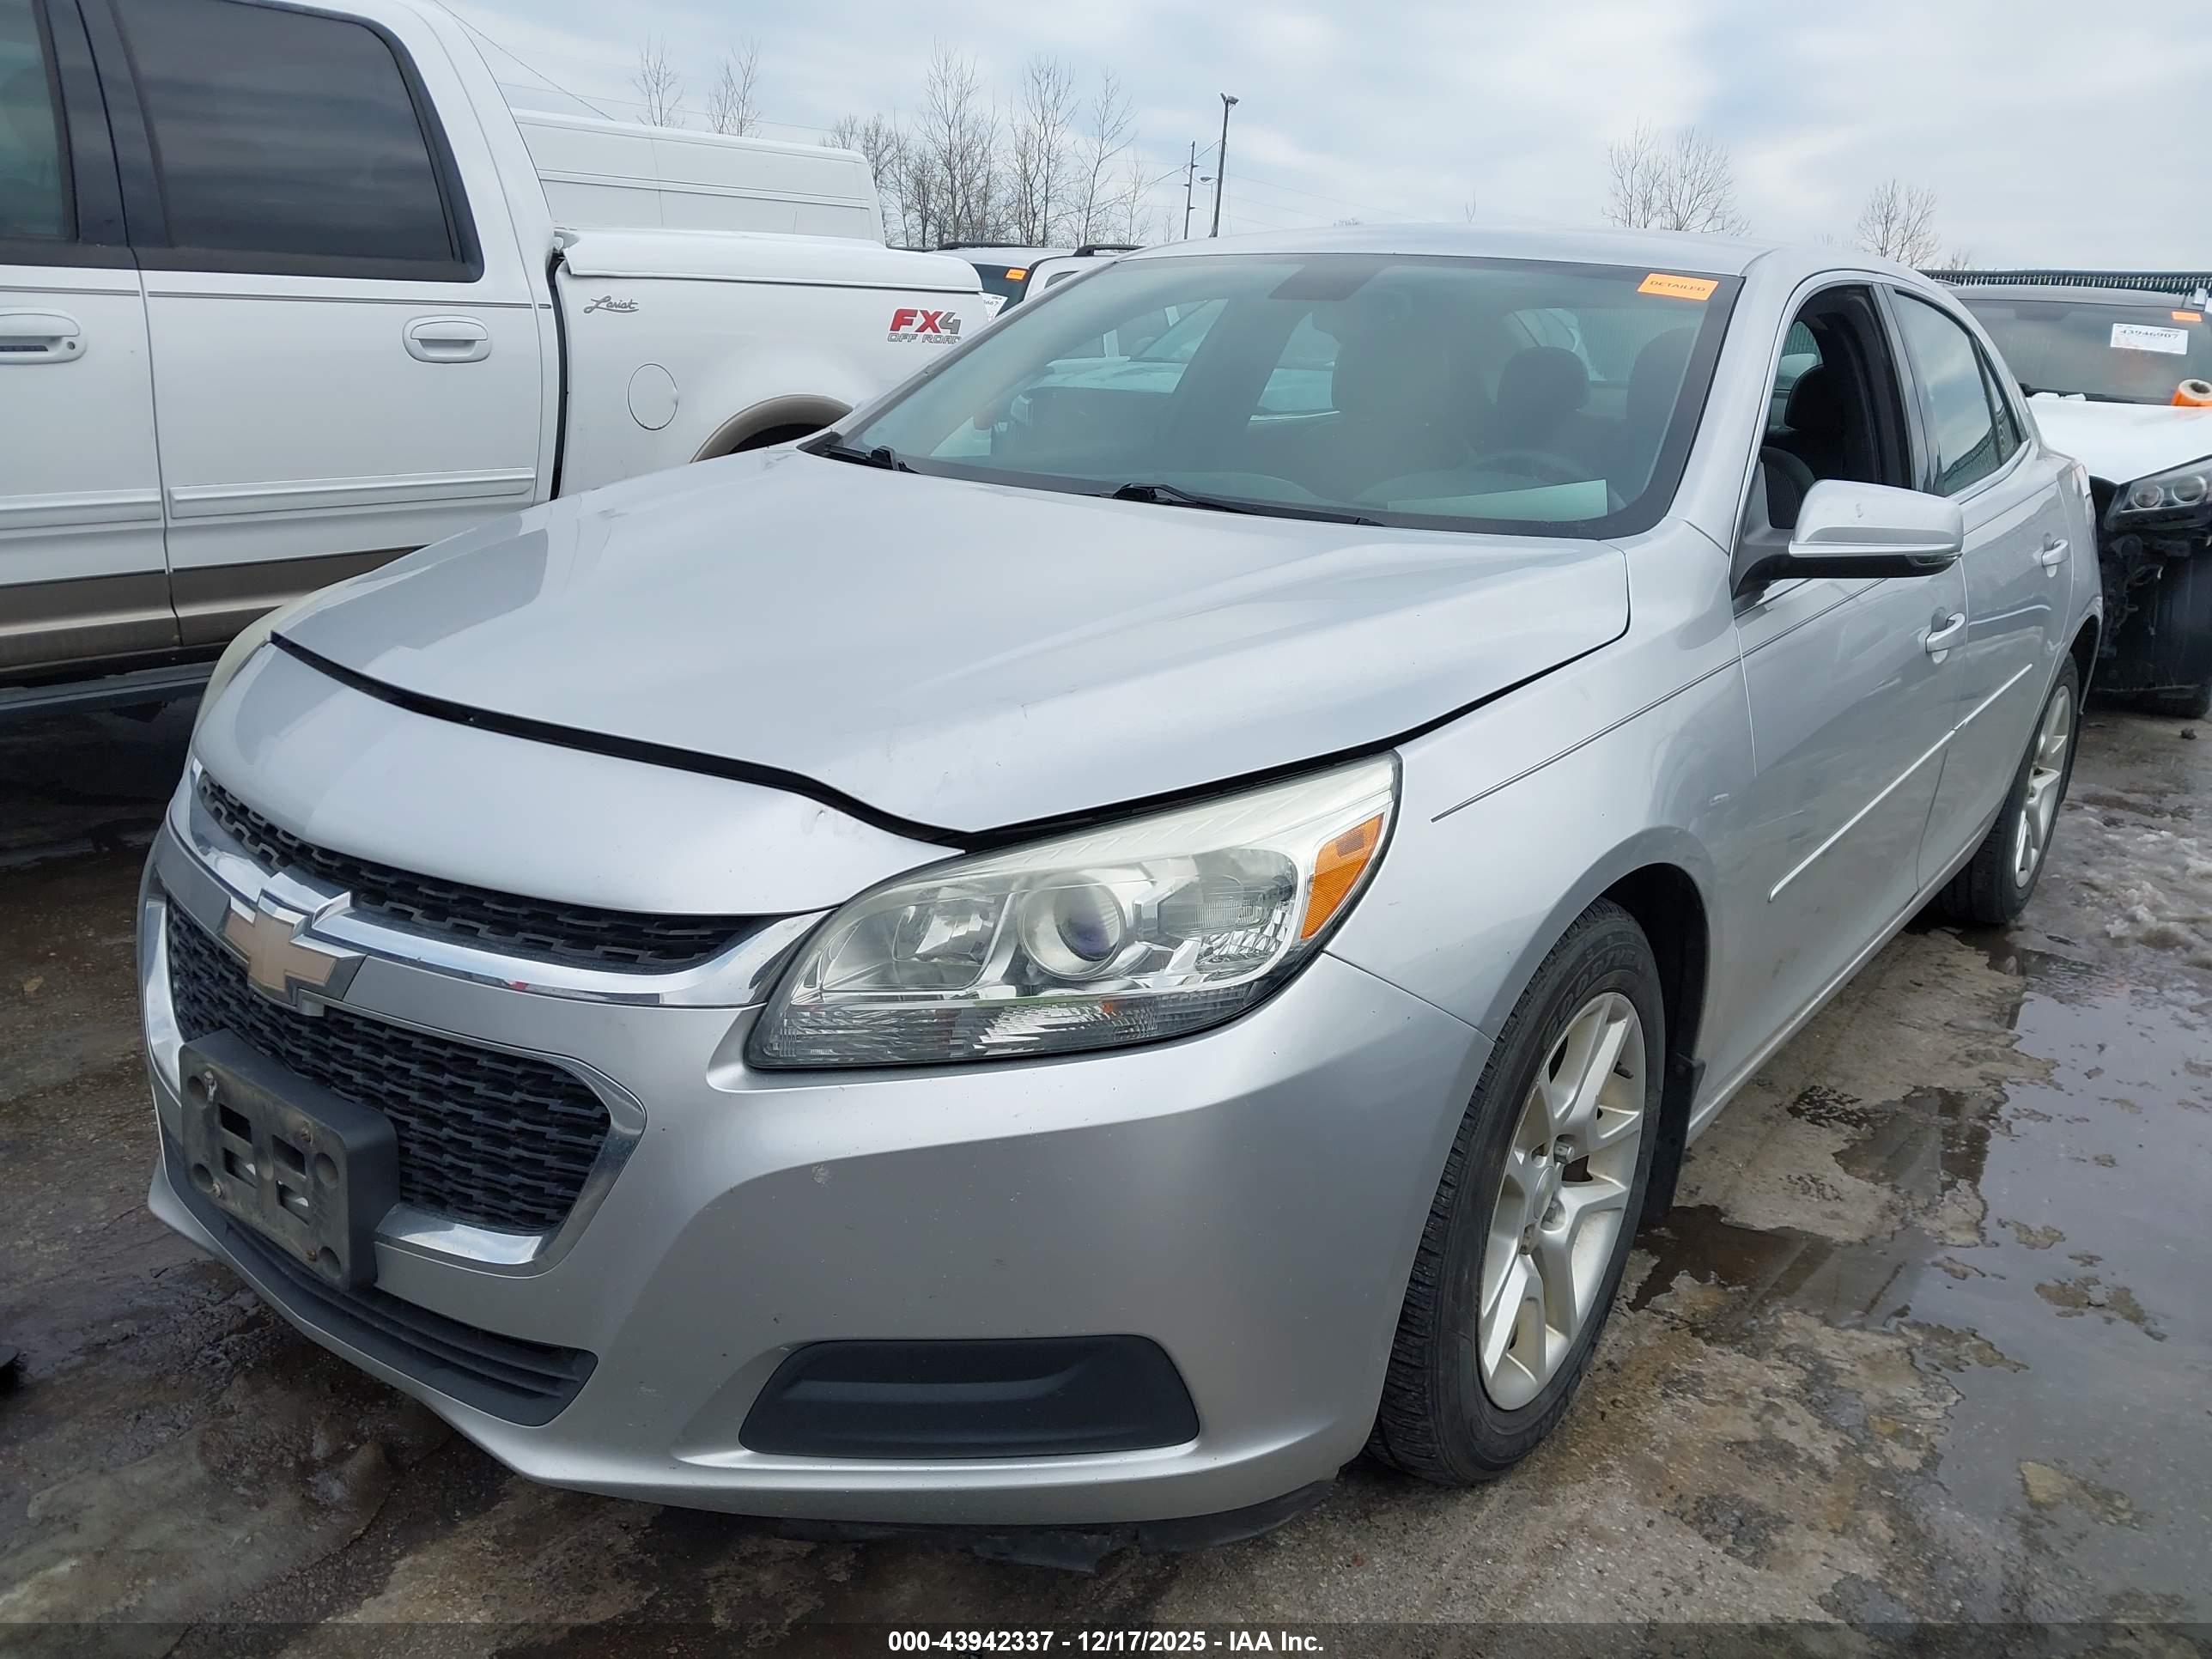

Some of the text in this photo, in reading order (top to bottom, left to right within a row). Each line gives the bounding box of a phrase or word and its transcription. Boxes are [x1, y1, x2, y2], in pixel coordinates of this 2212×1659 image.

[1650, 280, 1706, 292] DETAILED
[583, 295, 640, 313] Lariat
[889, 308, 962, 335] FX4
[887, 332, 918, 343] OFF
